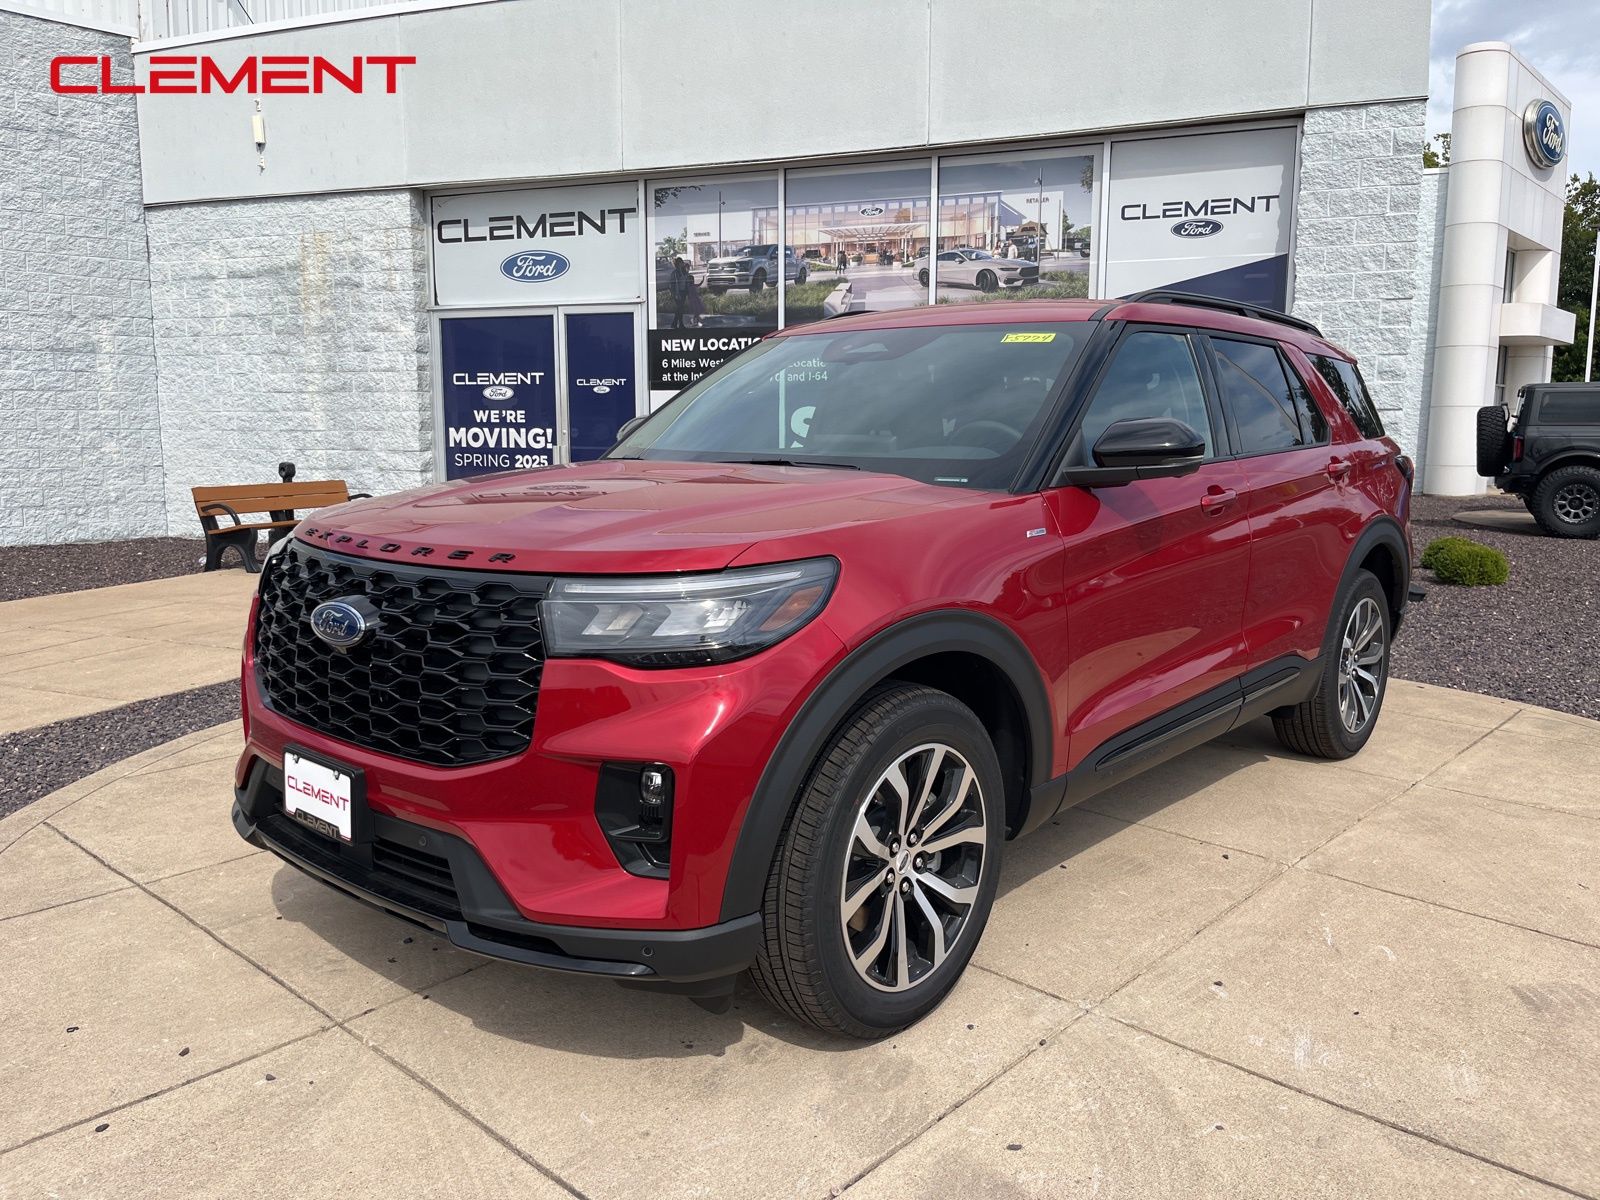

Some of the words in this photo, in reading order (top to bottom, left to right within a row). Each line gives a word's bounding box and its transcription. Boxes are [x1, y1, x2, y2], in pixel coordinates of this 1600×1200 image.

[1542, 113, 1564, 154] Ford
[1120, 194, 1280, 221] CLEMENT
[437, 207, 637, 244] CLEMENT
[1180, 220, 1213, 236] Ford
[512, 255, 556, 278] Ford
[661, 339, 696, 352] NEW
[661, 359, 669, 368] 6
[671, 358, 696, 368] Miles
[699, 358, 724, 368] Wes
[453, 372, 545, 385] CLEMENT
[576, 378, 627, 386] CLEMENT
[662, 372, 672, 382] at
[673, 372, 689, 382] the
[787, 371, 805, 382] and
[473, 409, 527, 423] WE'RE
[448, 426, 554, 449] MOVING!
[454, 453, 511, 468] SPRING
[514, 454, 550, 469] 2025
[303, 527, 516, 564] EXPLORER
[319, 609, 350, 637] Ford
[287, 774, 350, 812] CLEMENT
[296, 810, 341, 839] CLEMENT
